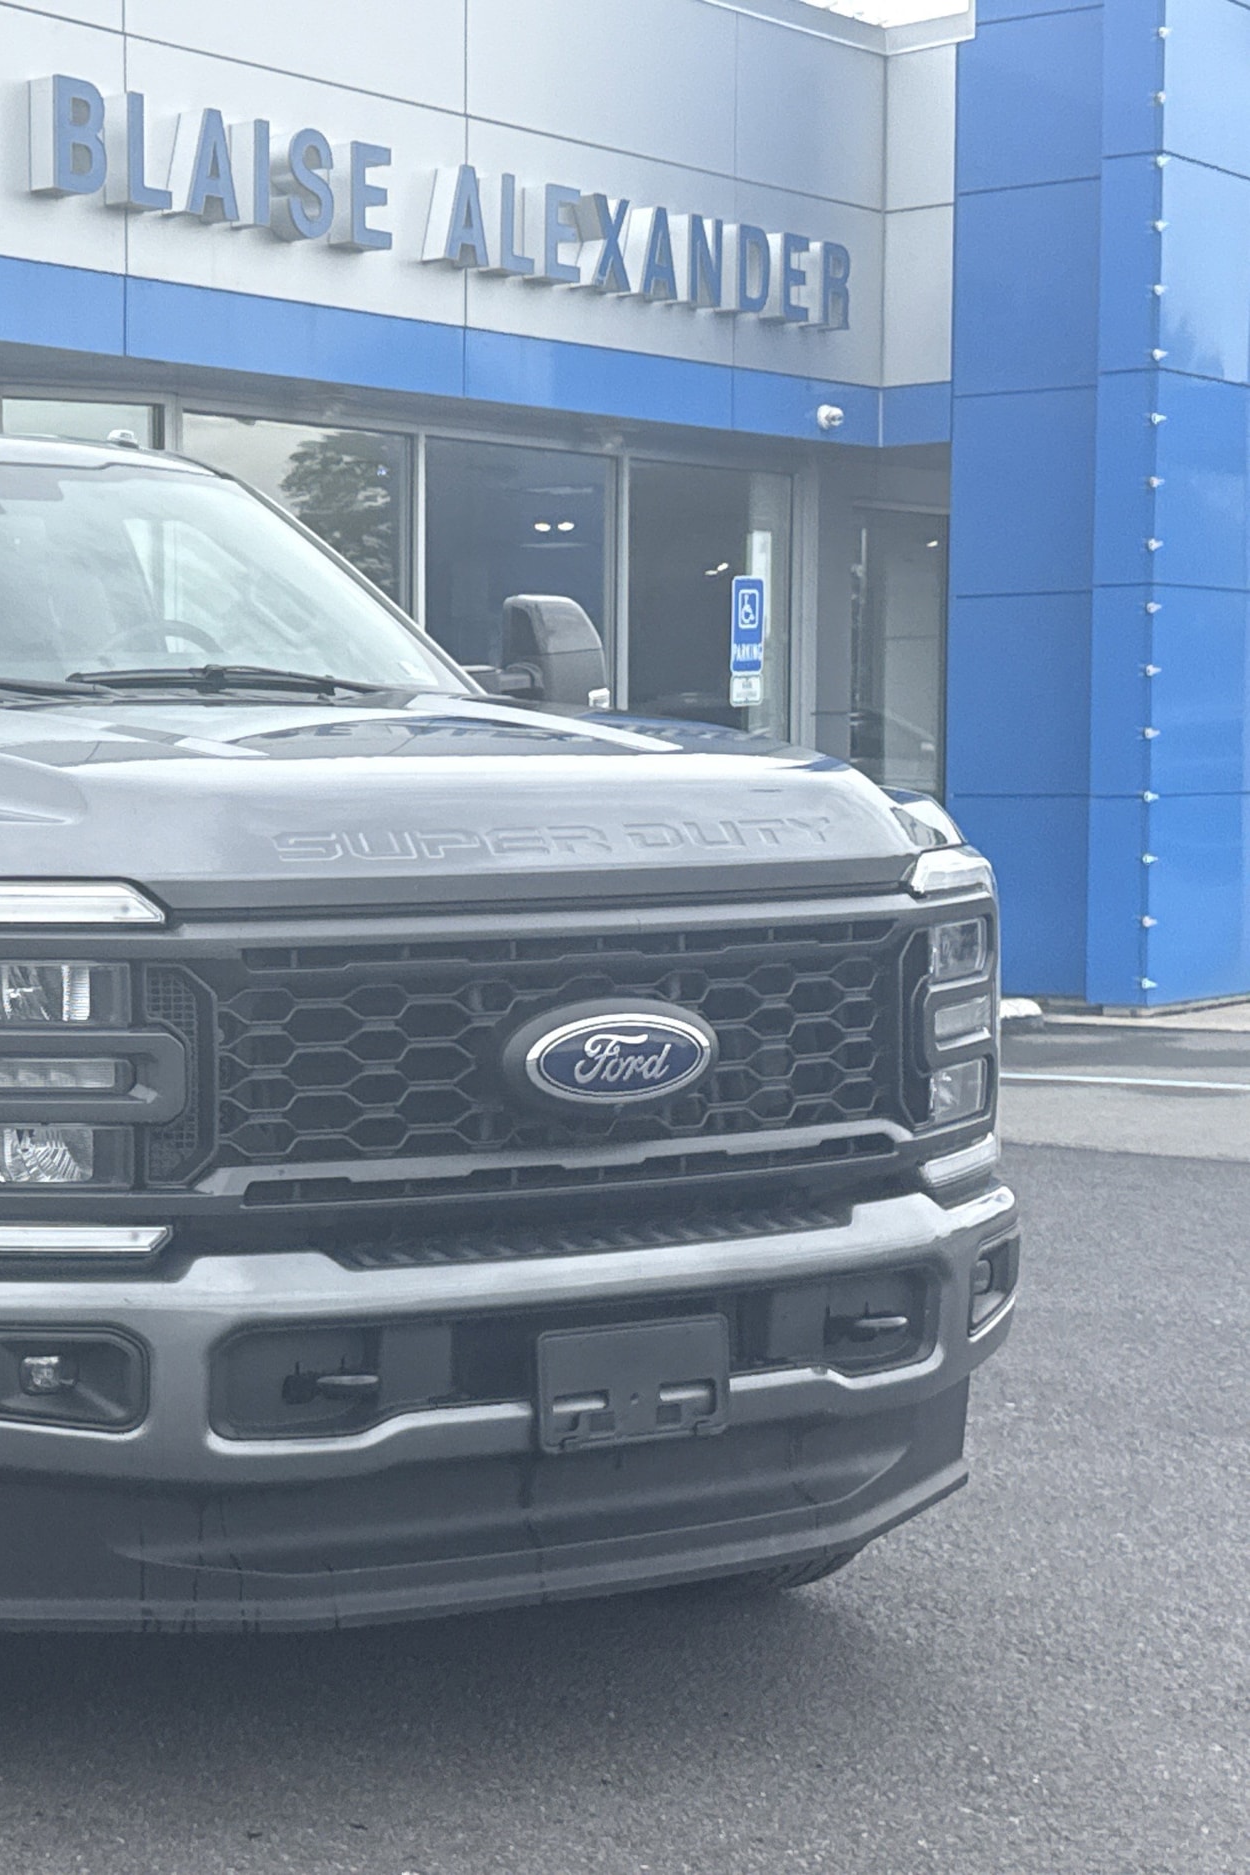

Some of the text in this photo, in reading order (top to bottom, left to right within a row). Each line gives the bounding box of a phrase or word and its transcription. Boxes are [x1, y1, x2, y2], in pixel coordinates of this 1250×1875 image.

[50, 74, 852, 331] BLAISE ALEXANDER
[733, 643, 762, 662] PARKING
[272, 815, 831, 862] SUPER DUTY
[574, 1034, 672, 1084] Ford
